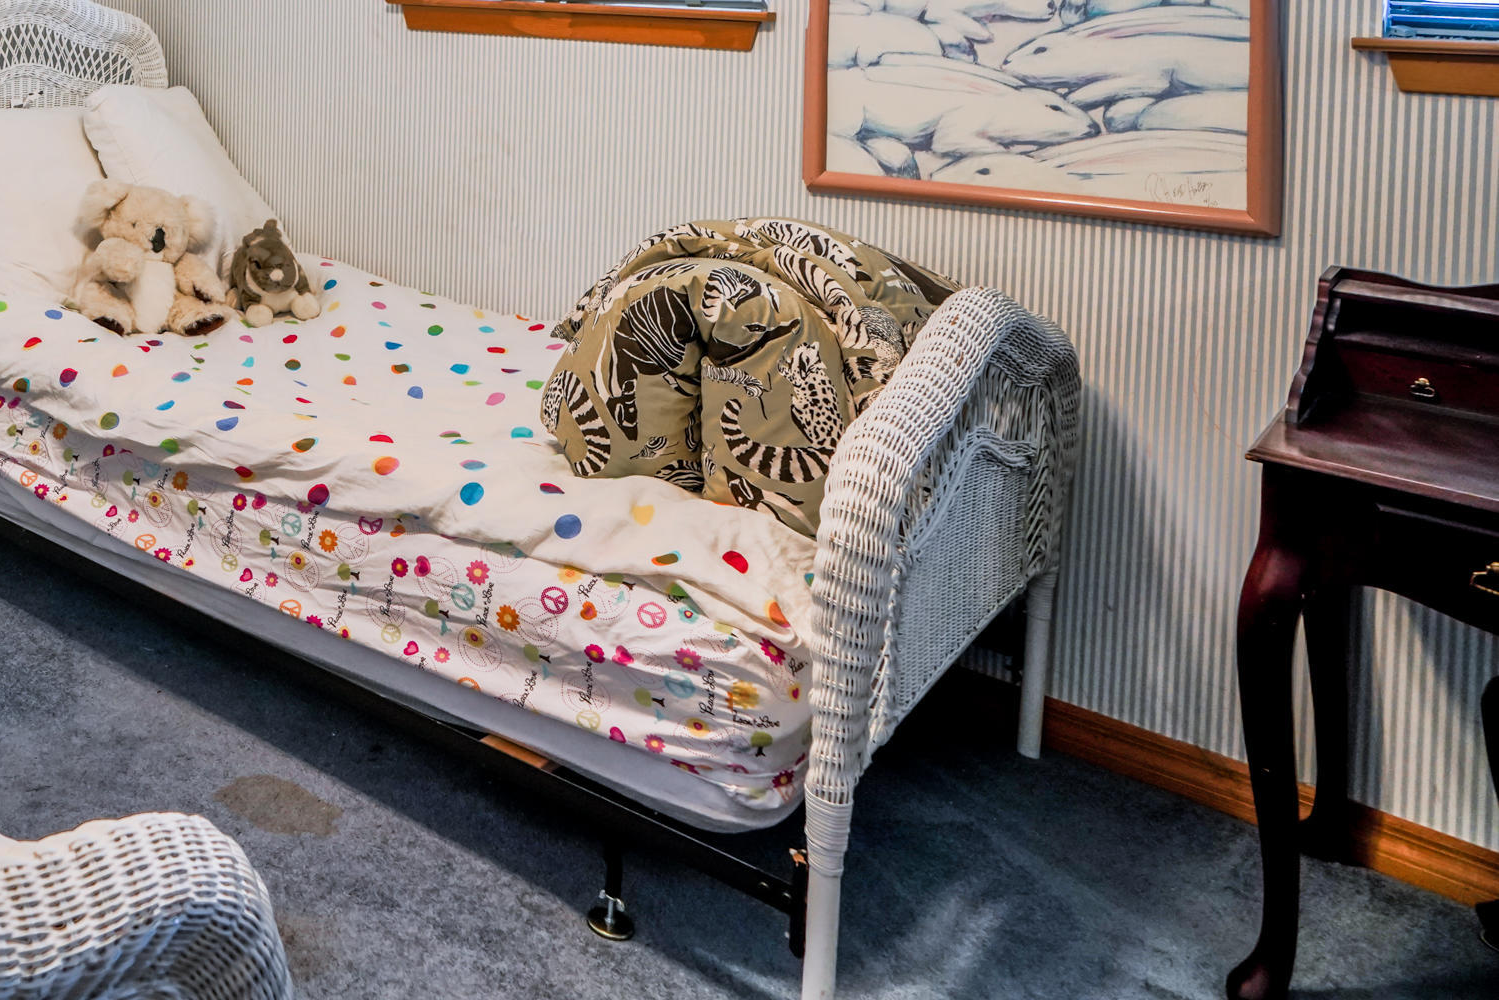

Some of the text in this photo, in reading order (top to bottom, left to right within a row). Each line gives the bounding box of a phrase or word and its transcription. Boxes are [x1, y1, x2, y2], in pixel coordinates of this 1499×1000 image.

[300, 531, 315, 552] Peace
[476, 582, 495, 629] Peace Love
[327, 609, 344, 629] Peace
[524, 670, 538, 692] Love
